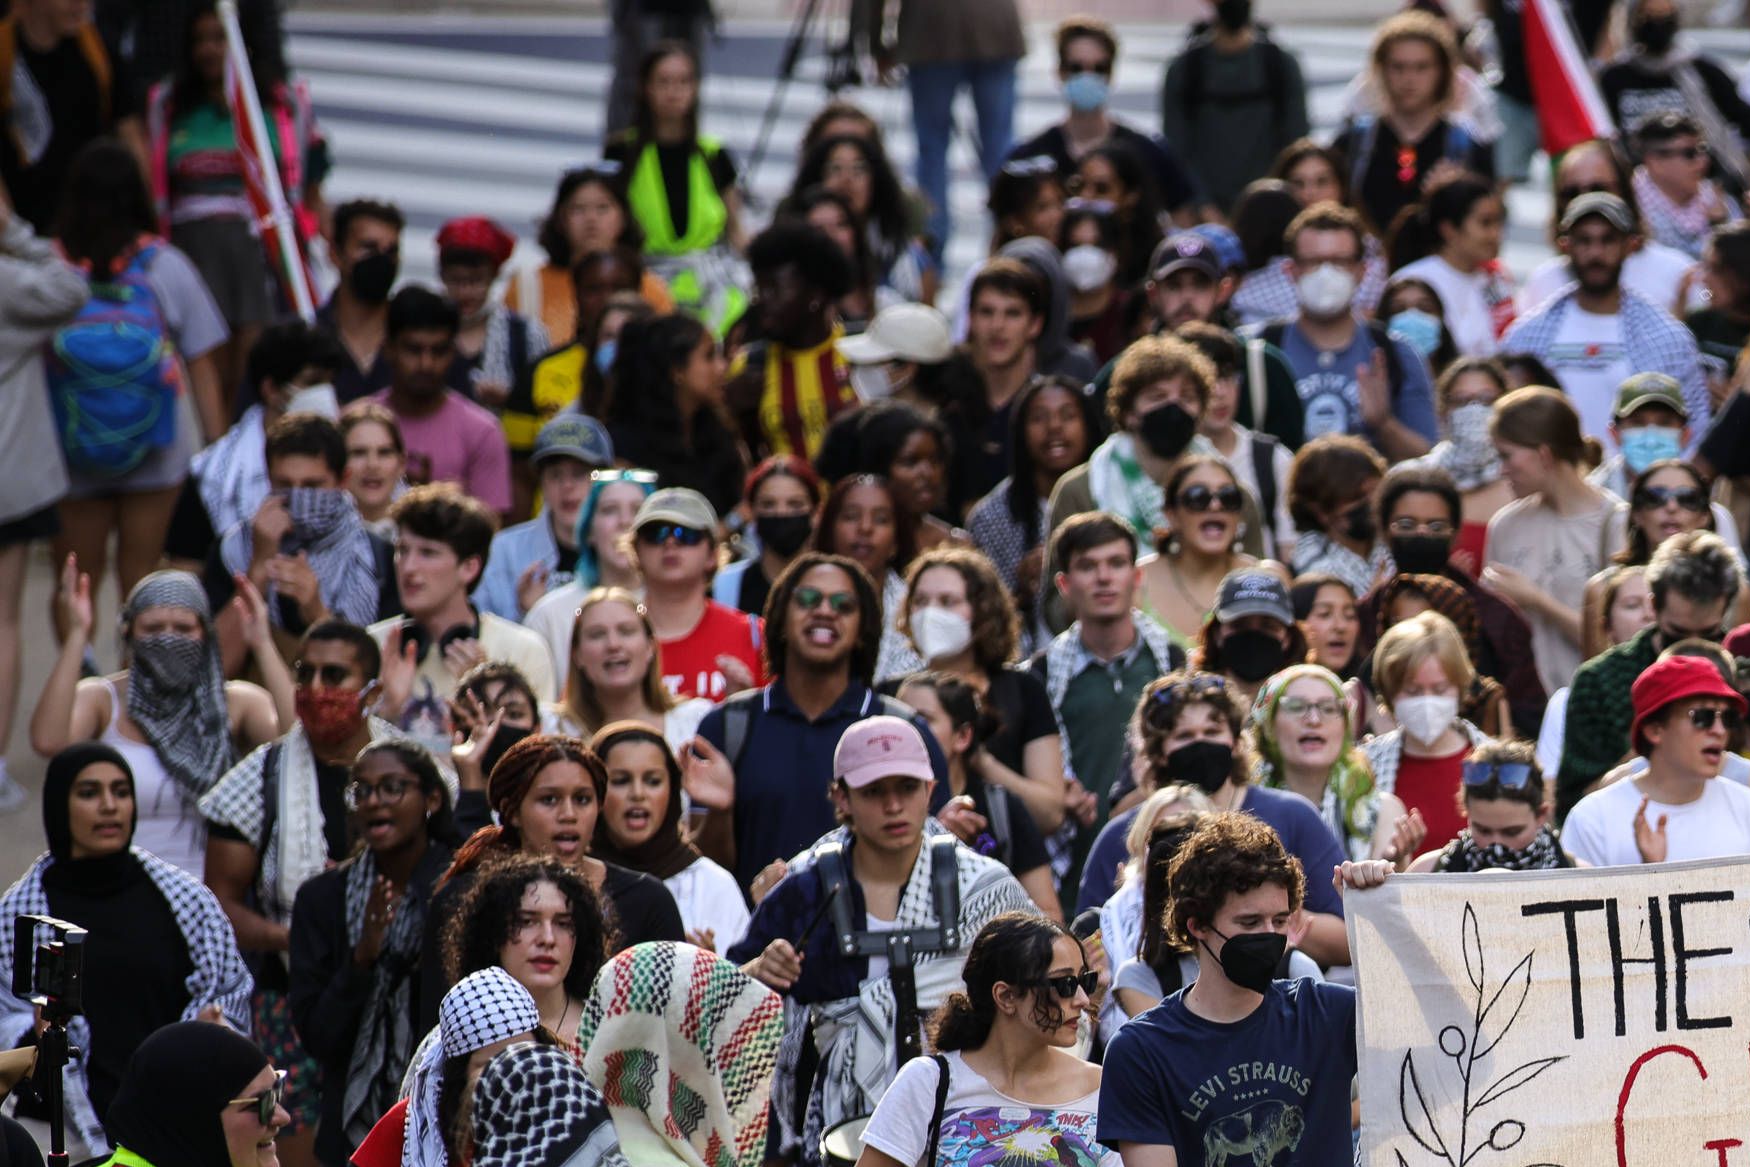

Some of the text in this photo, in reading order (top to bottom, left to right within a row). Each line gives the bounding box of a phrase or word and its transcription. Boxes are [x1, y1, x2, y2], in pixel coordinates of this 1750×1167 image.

[1522, 890, 1736, 1040] THE
[1181, 1060, 1312, 1122] LEVI STRAUSS
